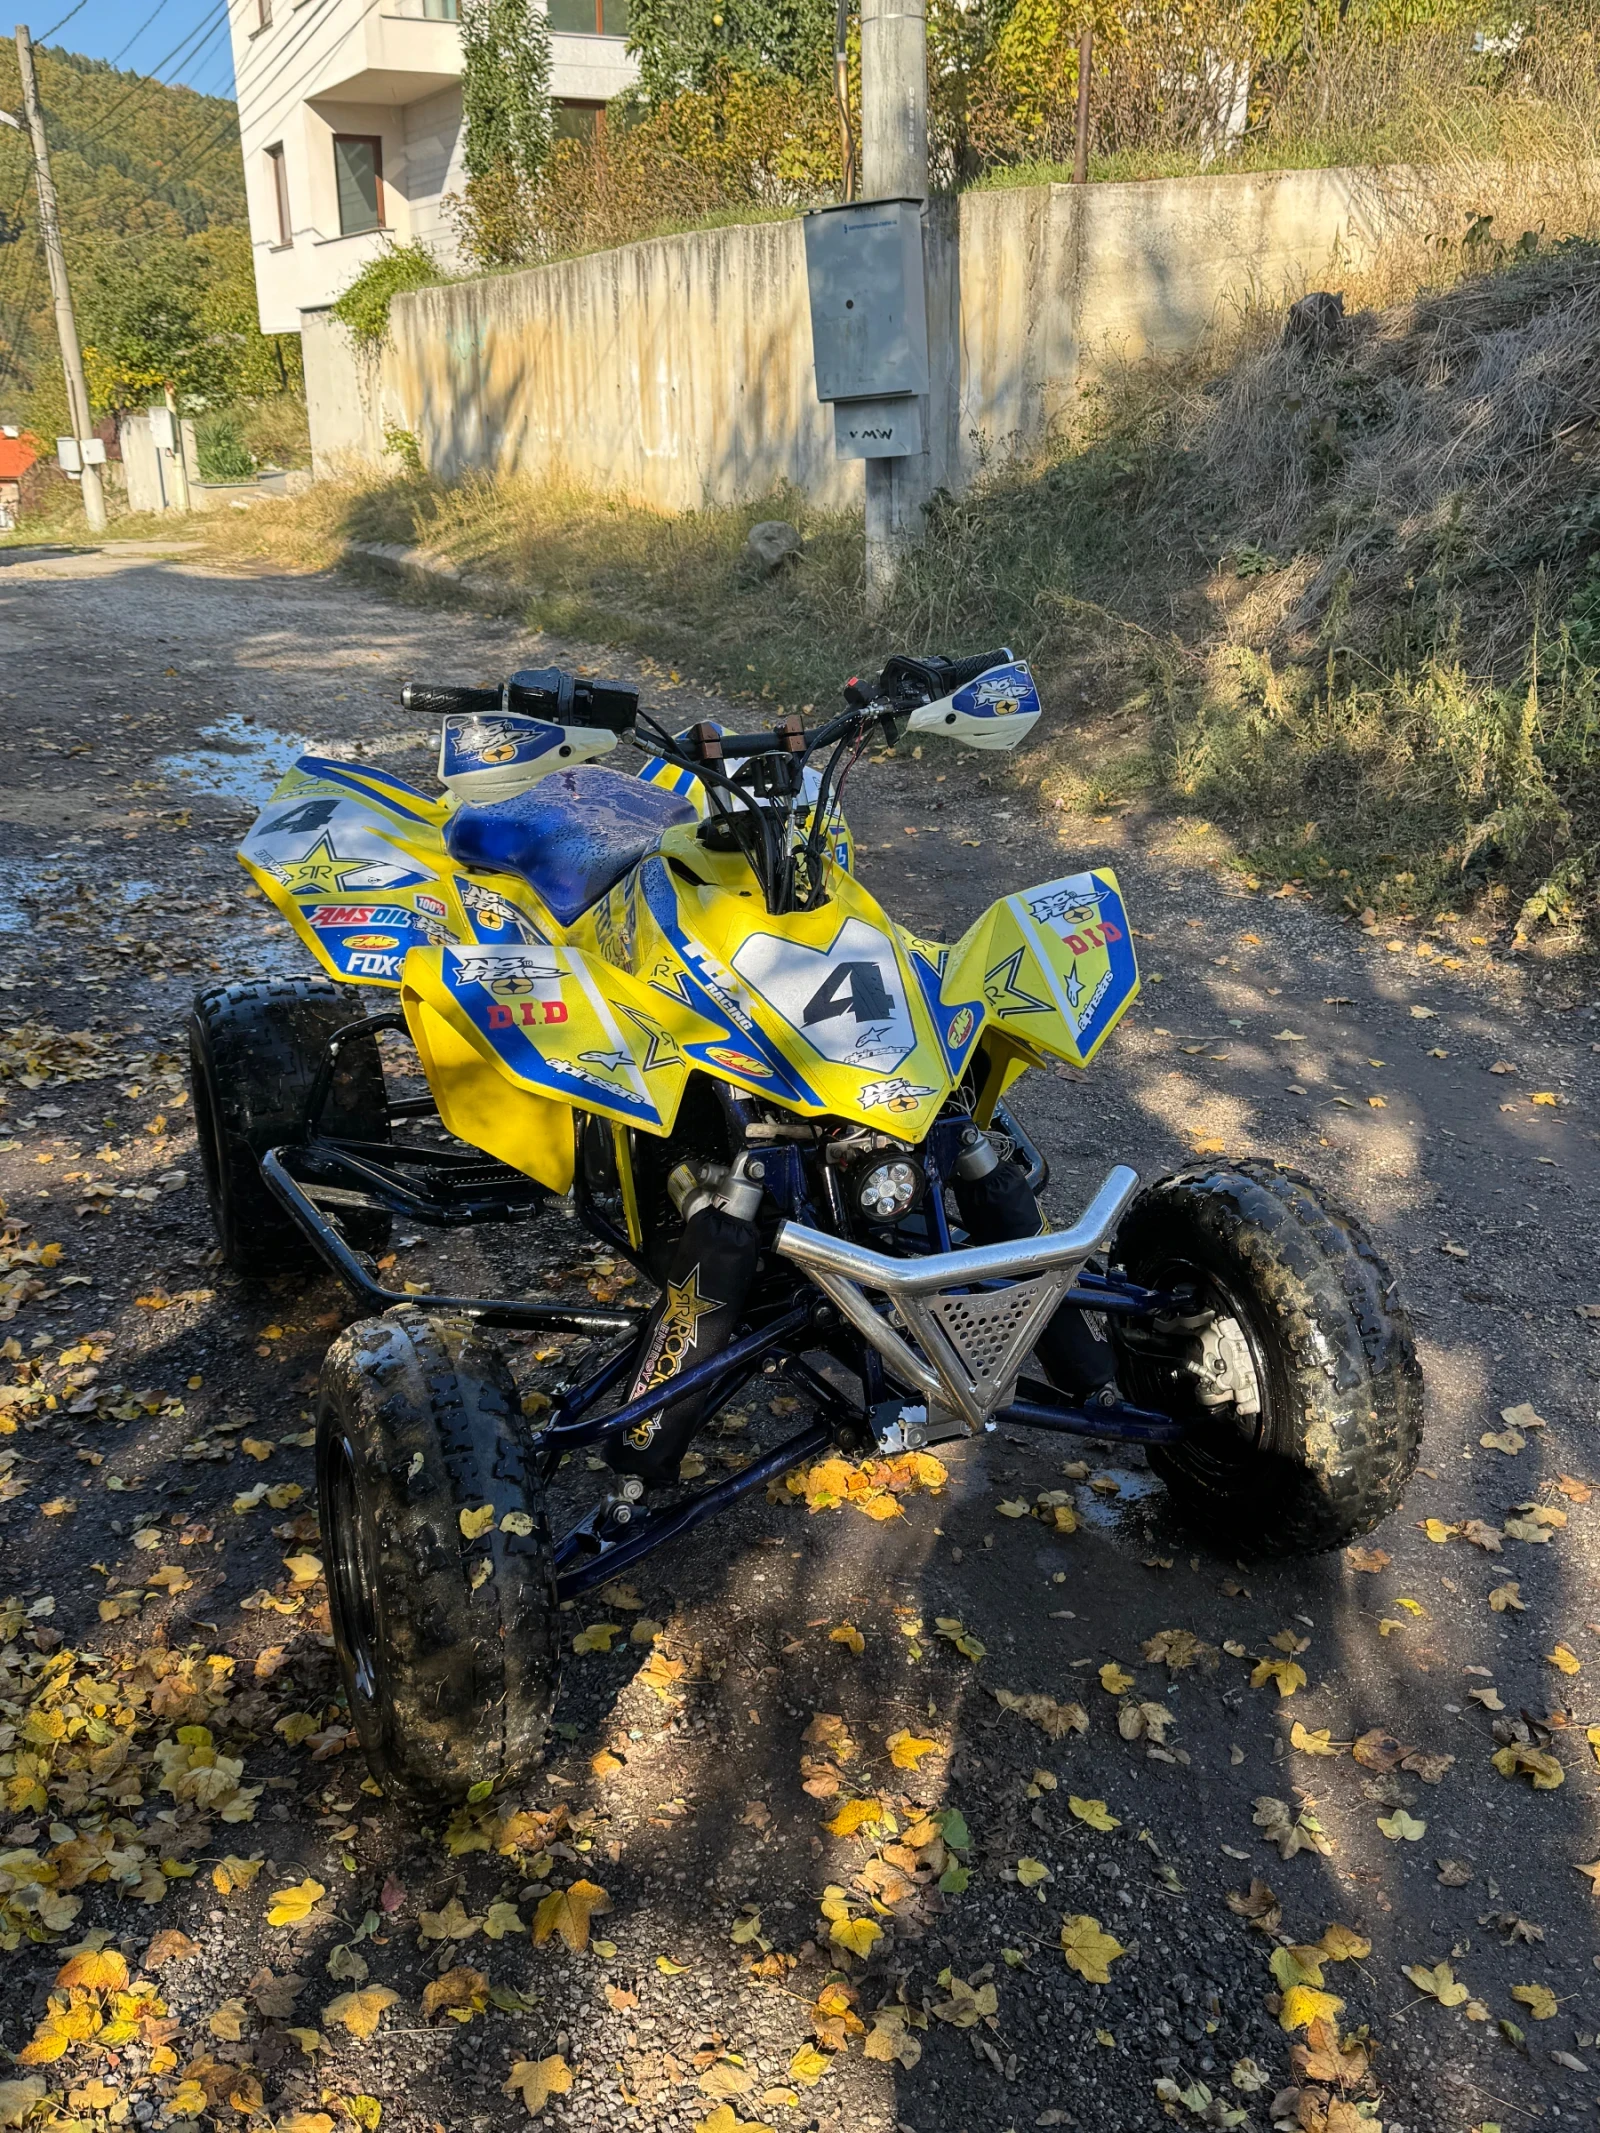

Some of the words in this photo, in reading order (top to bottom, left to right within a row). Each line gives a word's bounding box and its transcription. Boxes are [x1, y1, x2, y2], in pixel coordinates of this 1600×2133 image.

[252, 799, 342, 838] 4
[418, 897, 445, 915] 100%
[463, 893, 519, 920] FEAR
[467, 884, 501, 902] NO
[306, 905, 412, 929] AMSOIL
[1029, 891, 1110, 924] FEAR
[343, 936, 399, 949] FMF
[346, 952, 398, 976] FOX
[456, 967, 572, 984] FEAR
[464, 957, 526, 970] NO
[705, 983, 753, 1030] RACING
[801, 962, 896, 1028] 4
[1077, 969, 1113, 1033] alpinestars
[706, 1048, 774, 1076] FMF
[544, 1057, 645, 1104] alpinestars
[857, 1086, 938, 1110] FEAR
[642, 1323, 670, 1382] ENERGY
